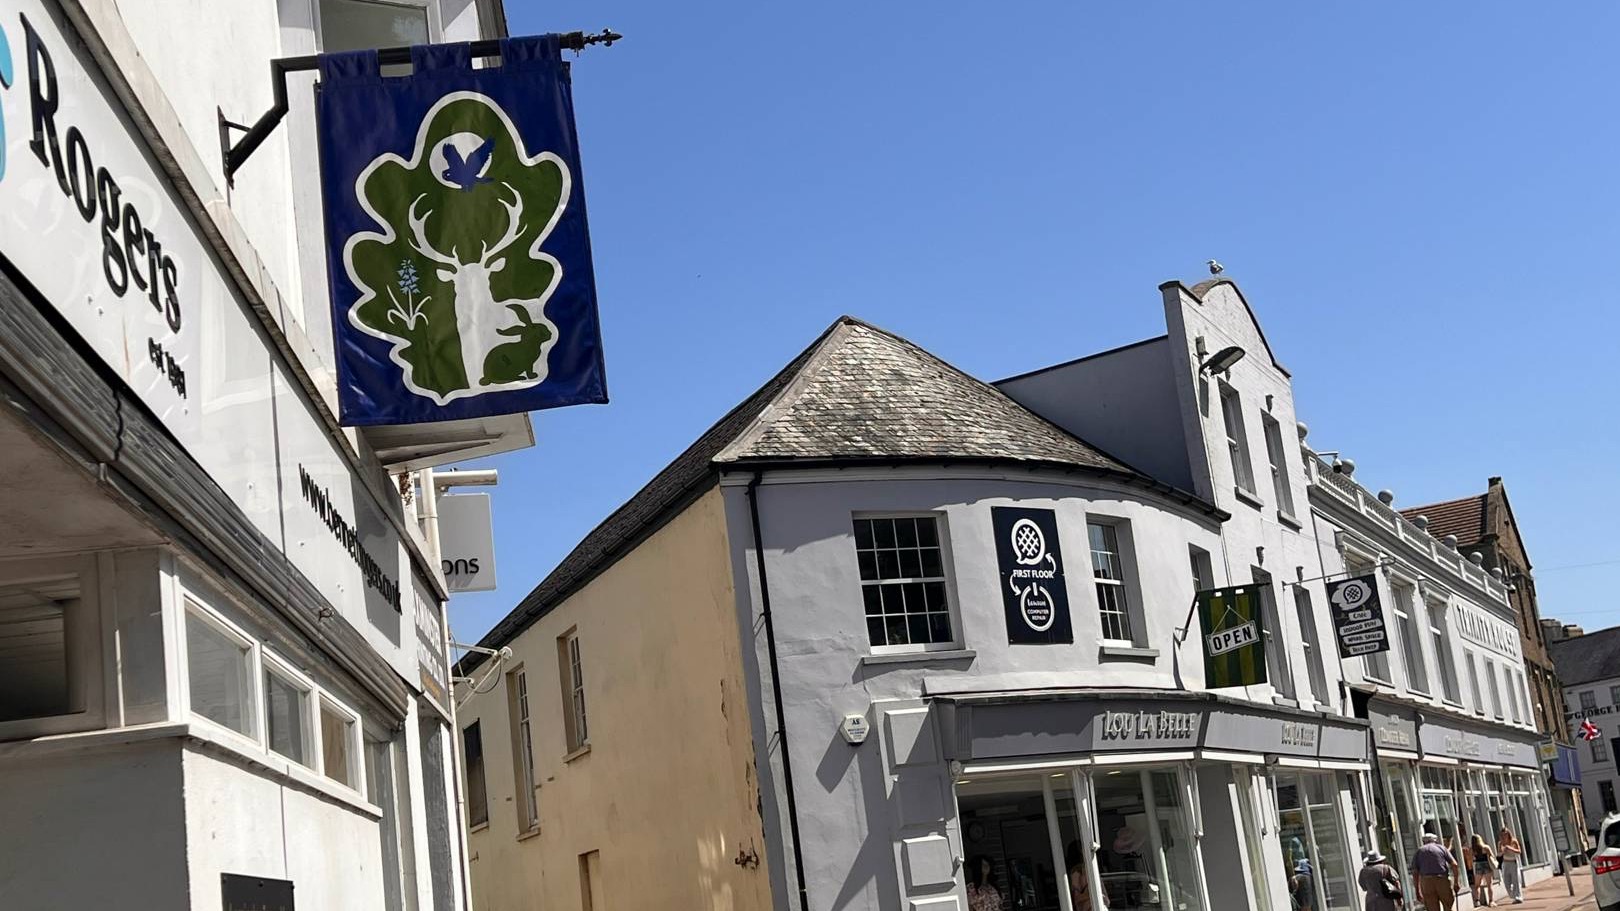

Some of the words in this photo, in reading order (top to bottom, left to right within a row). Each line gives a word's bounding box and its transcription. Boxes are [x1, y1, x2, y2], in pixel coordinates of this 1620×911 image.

[20, 12, 181, 334] Rogers
[1012, 569, 1031, 578] FIRST
[1031, 569, 1054, 579] FLOOR
[1212, 626, 1252, 650] OPEN
[1106, 710, 1134, 732] LOU
[1140, 710, 1155, 732] LA
[1160, 710, 1196, 731] BELLE
[1574, 705, 1613, 719] GEORGE
